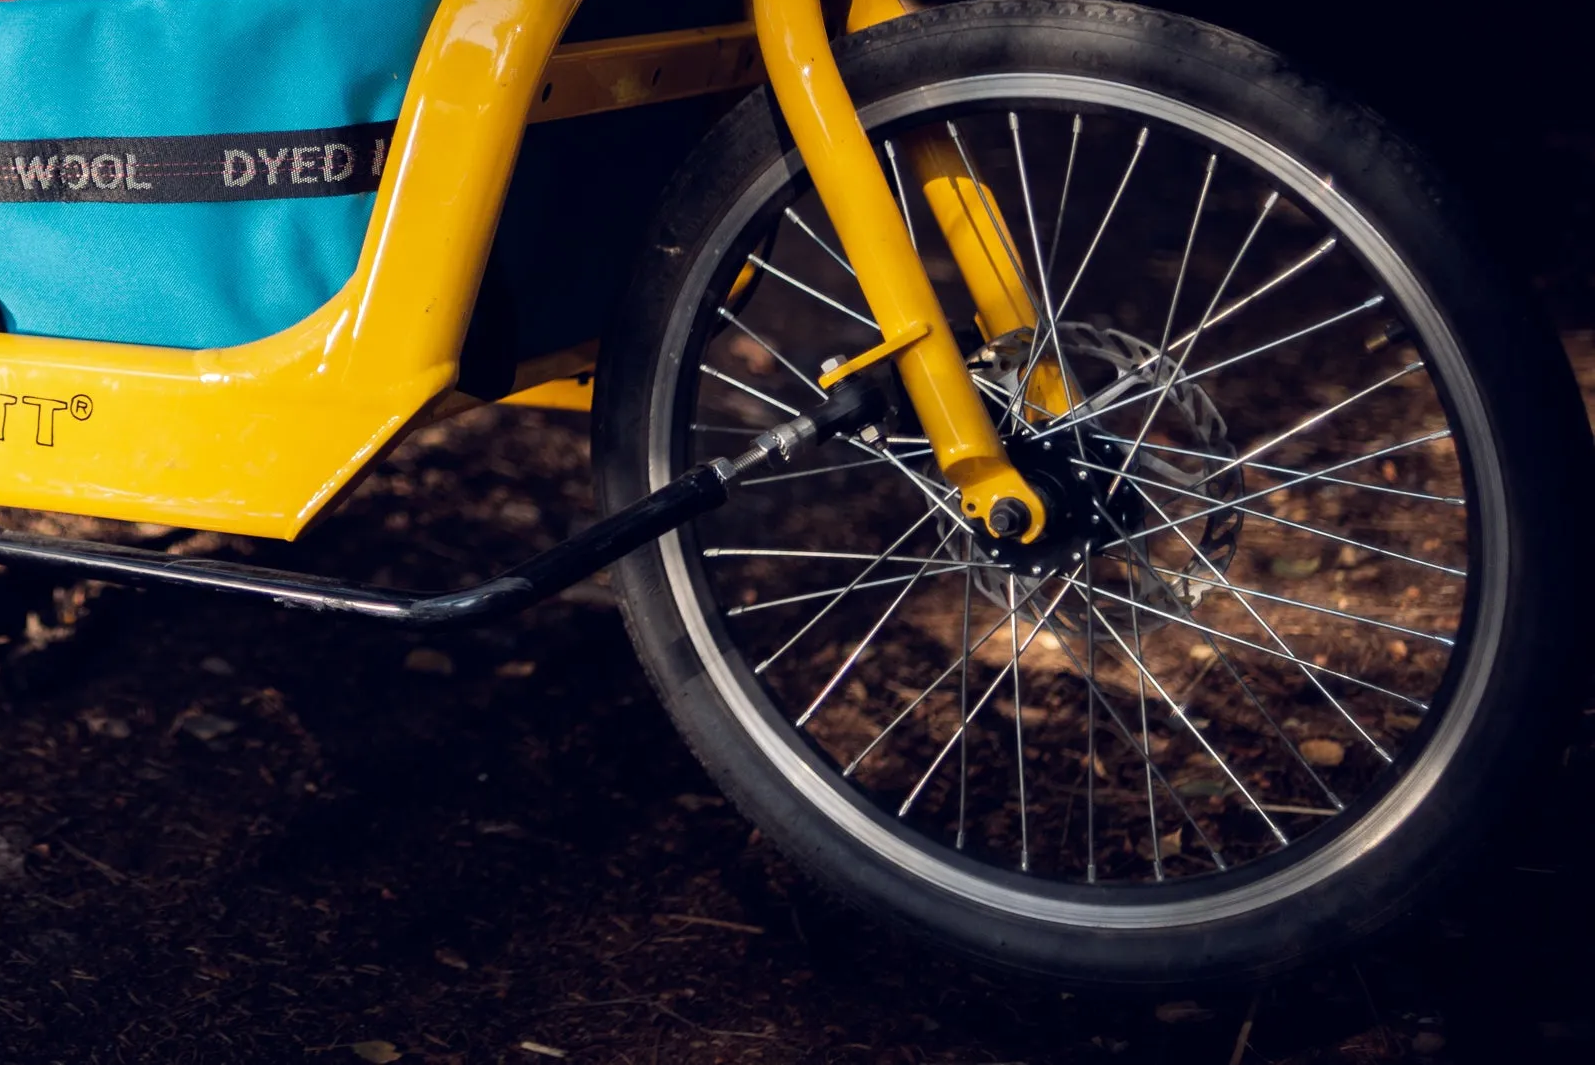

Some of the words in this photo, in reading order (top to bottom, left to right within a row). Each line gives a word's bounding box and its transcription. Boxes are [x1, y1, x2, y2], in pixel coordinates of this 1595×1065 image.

[13, 152, 153, 191] WOOL
[223, 142, 355, 188] DYED
[371, 138, 386, 177] I
